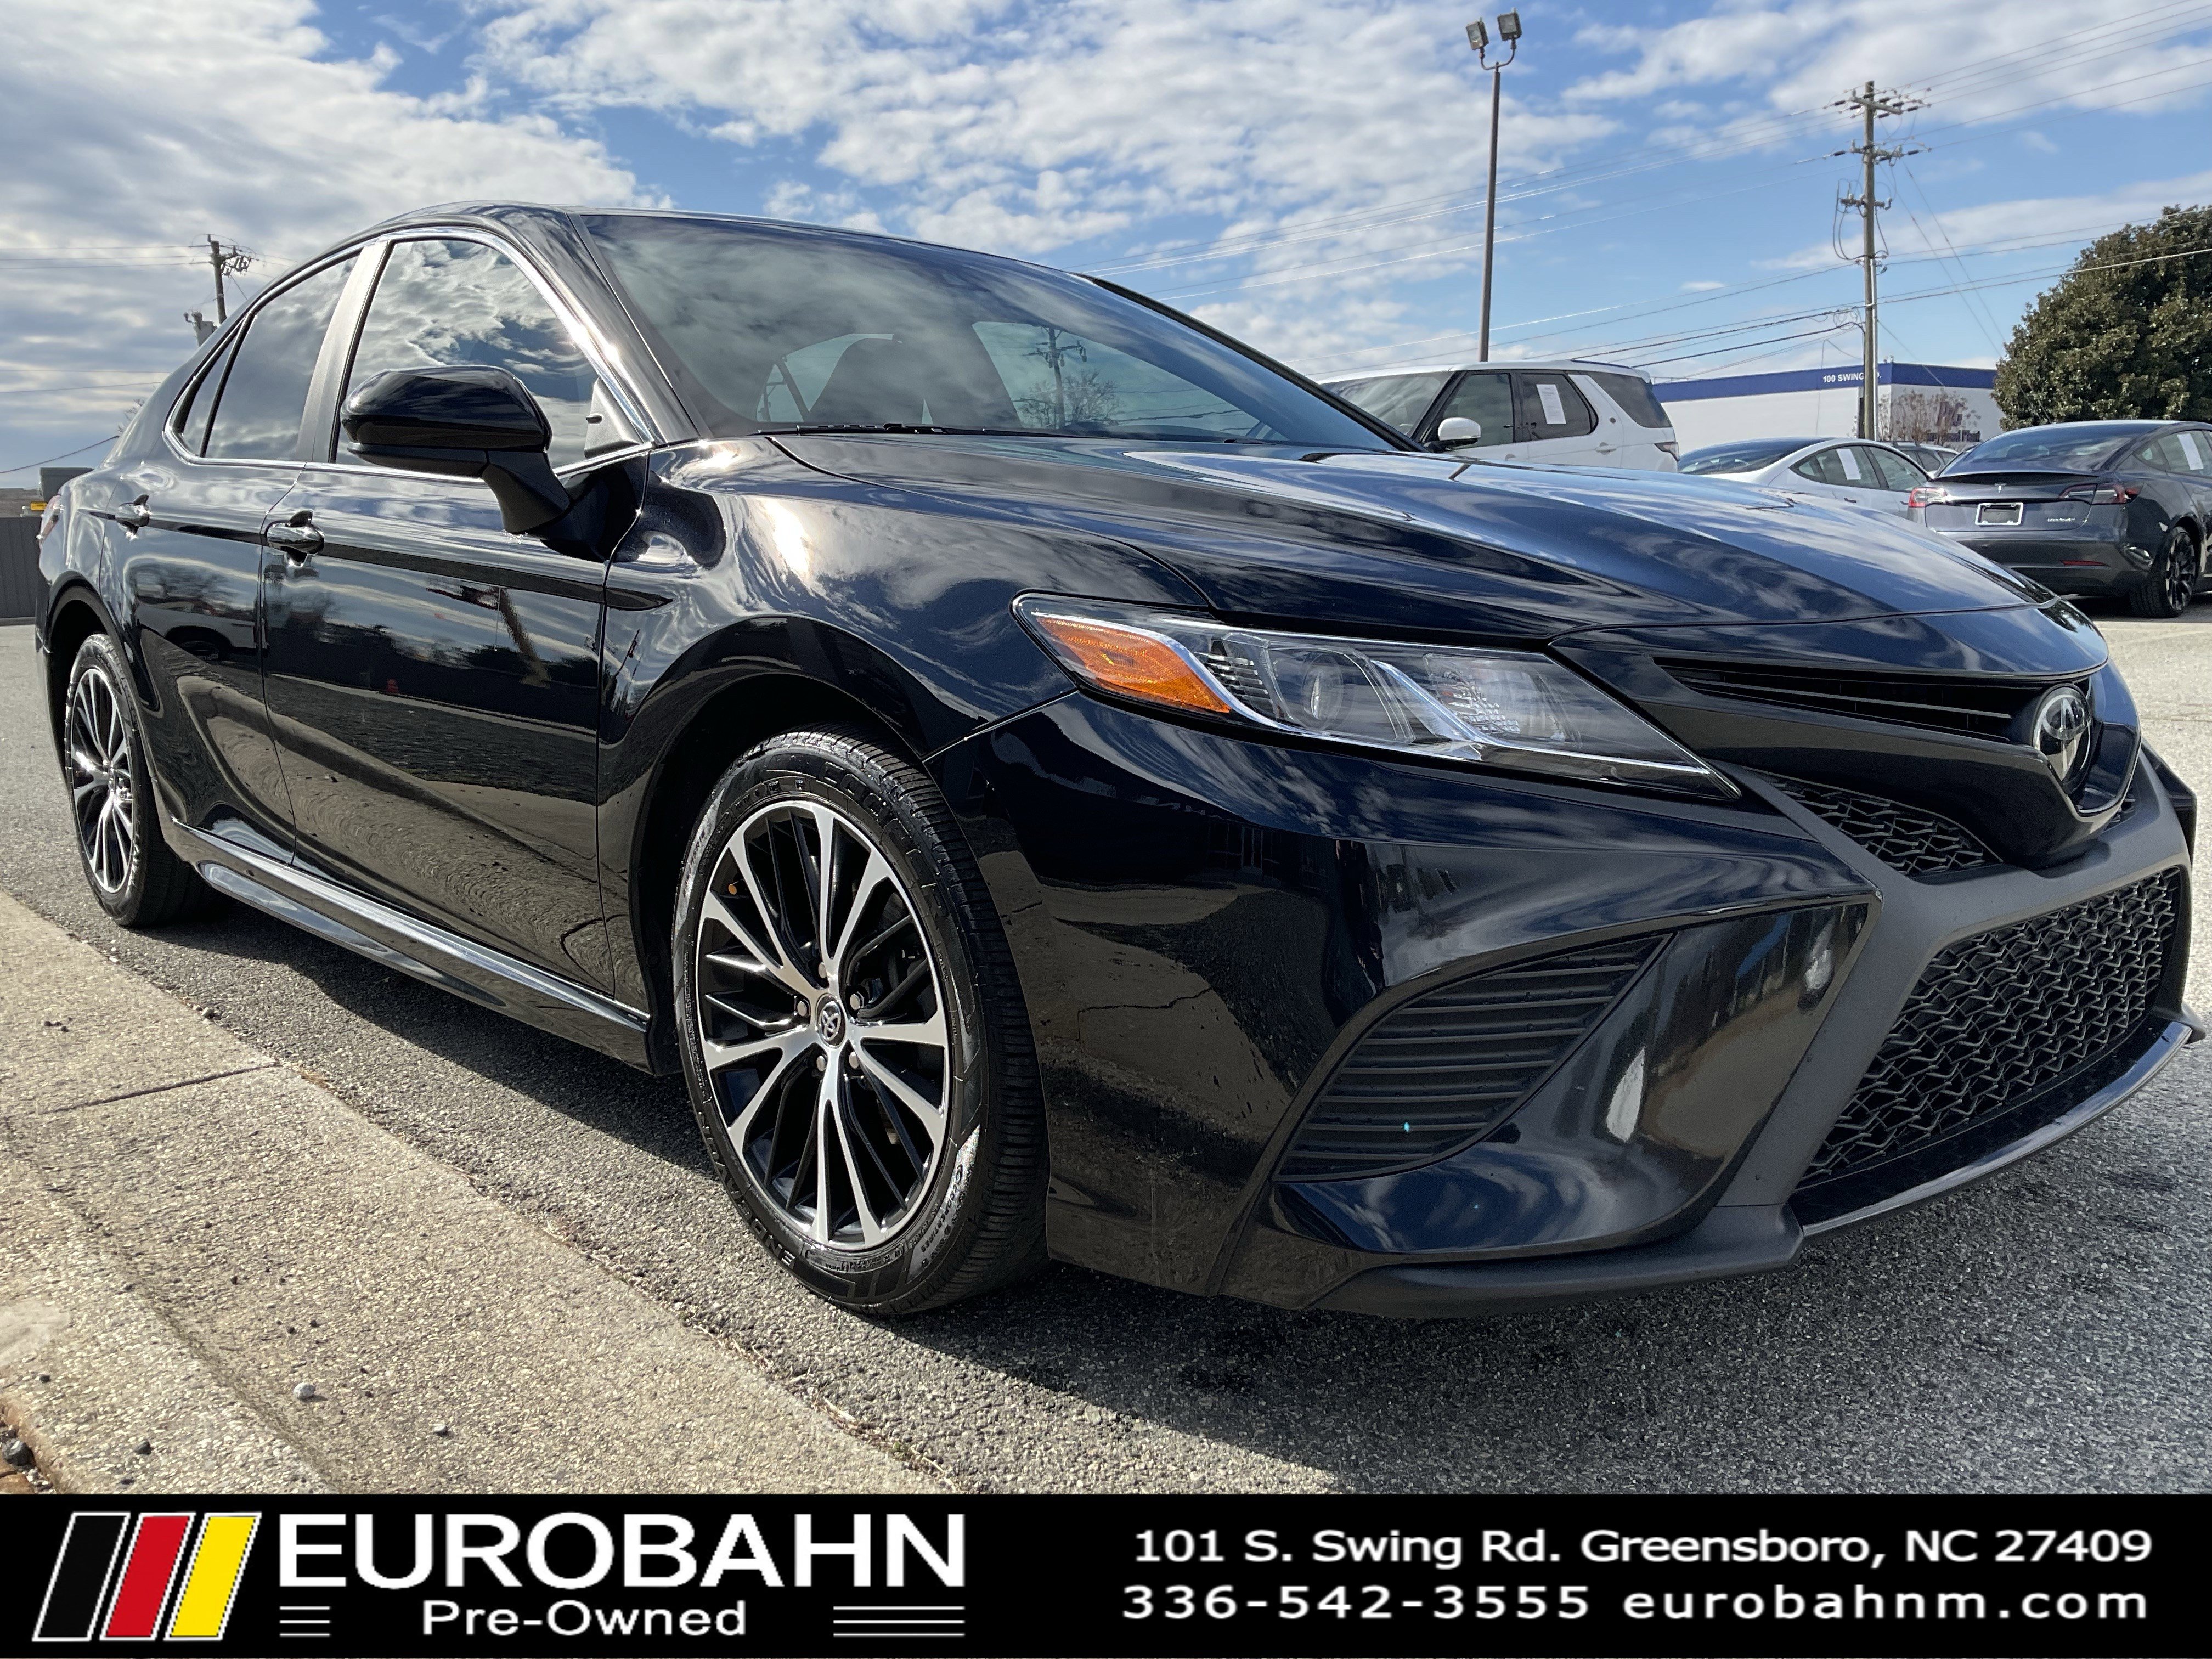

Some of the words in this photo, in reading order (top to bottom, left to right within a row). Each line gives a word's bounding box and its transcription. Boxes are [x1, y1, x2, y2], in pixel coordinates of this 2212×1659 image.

[1823, 375, 1836, 383] 100
[1837, 373, 1864, 382] SWING
[697, 1110, 795, 1268] ENDEAVOR
